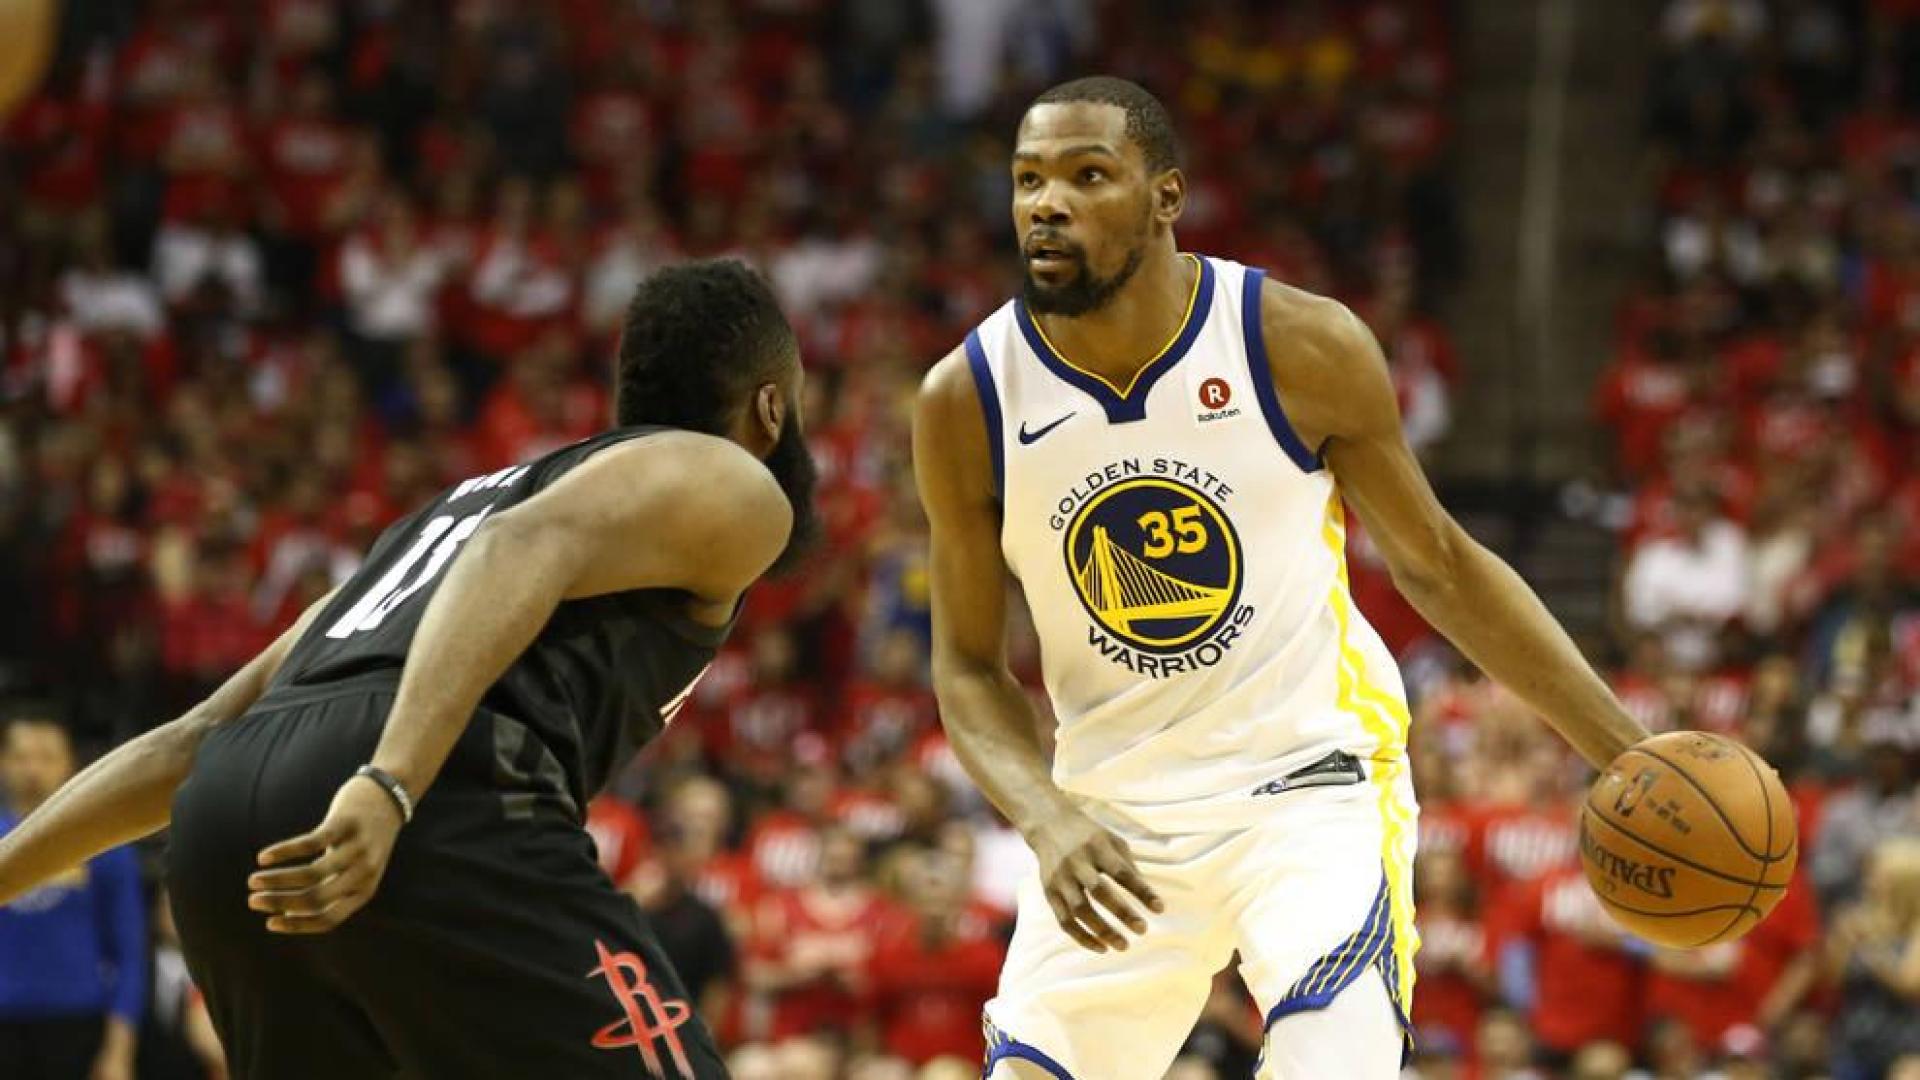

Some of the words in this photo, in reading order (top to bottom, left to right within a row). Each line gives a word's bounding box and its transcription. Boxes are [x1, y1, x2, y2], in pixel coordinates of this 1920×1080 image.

[1207, 384, 1225, 404] R
[1050, 458, 1141, 531] GOLDEN
[1153, 458, 1234, 503] STATE
[1136, 504, 1209, 559] 35
[1088, 604, 1255, 679] WARRIORS
[1580, 818, 1677, 898] SPALD
